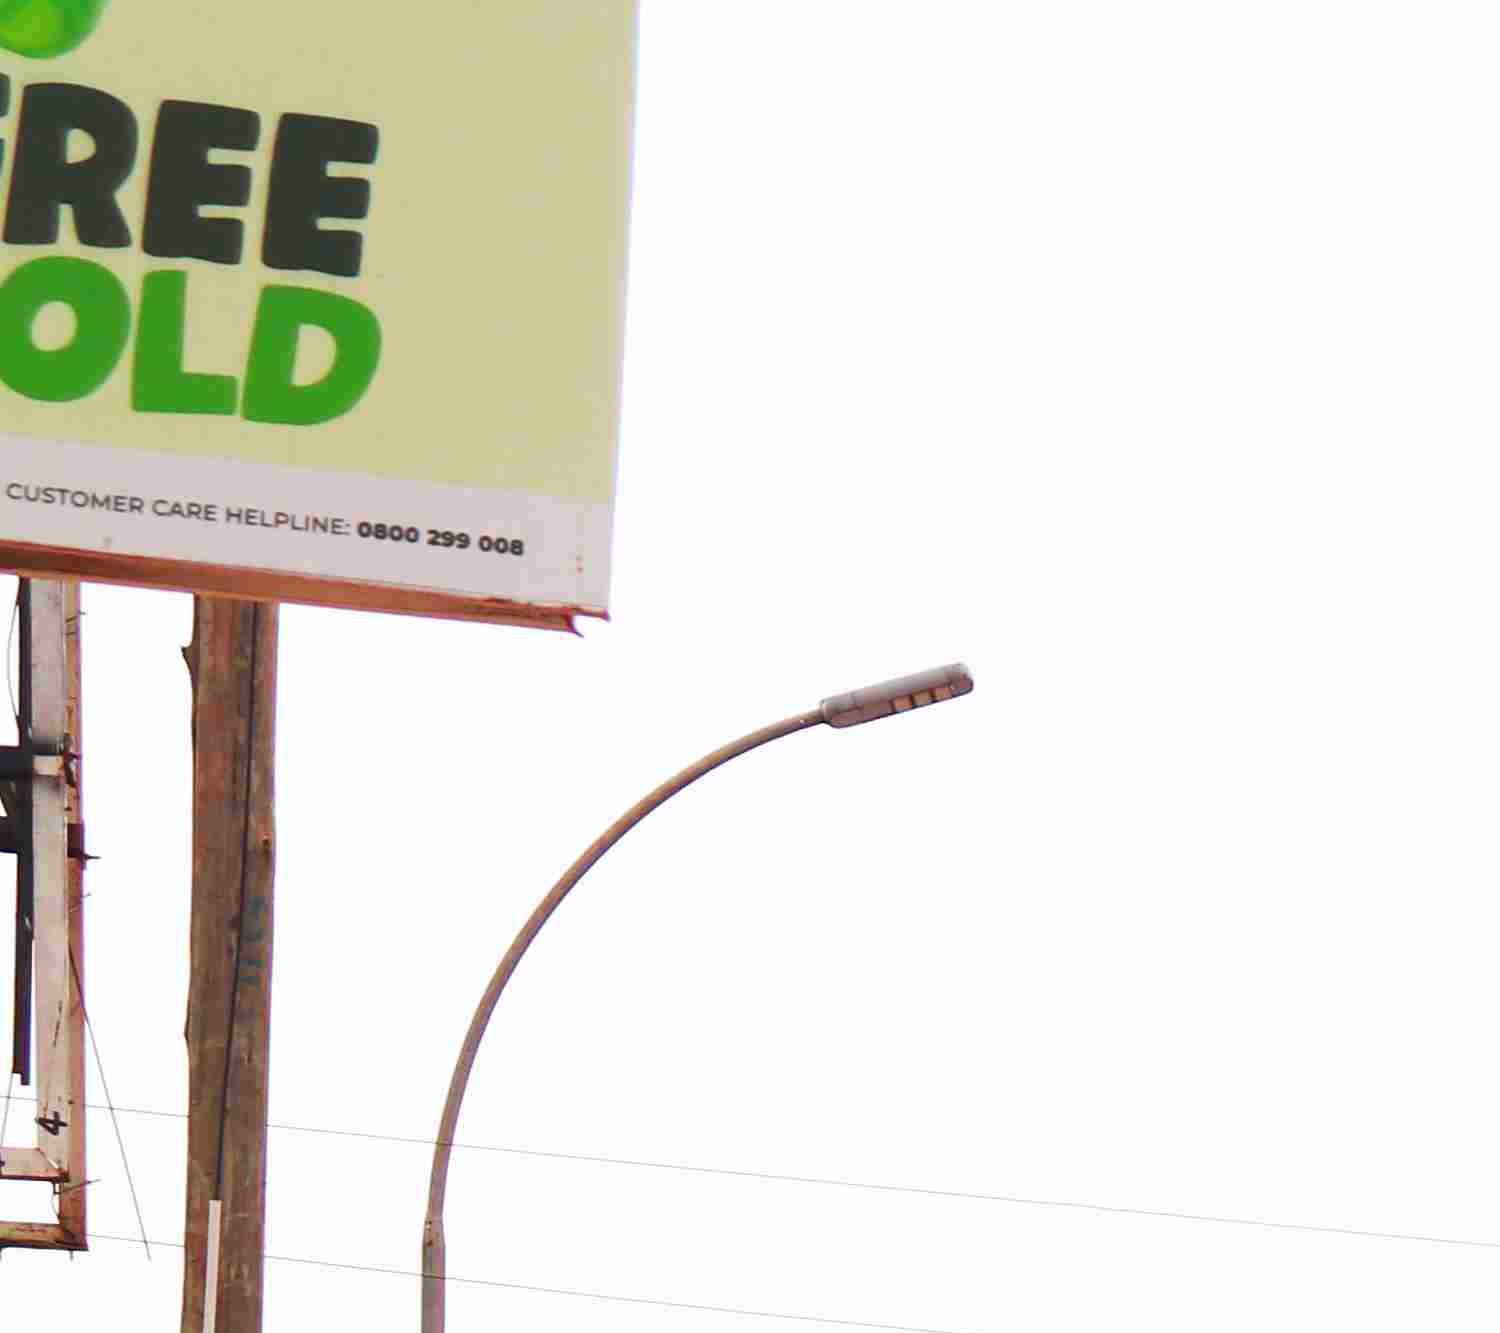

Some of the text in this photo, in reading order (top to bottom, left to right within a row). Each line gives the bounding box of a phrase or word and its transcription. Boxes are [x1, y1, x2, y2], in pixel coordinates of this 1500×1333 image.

[0, 73, 379, 278] REE
[6, 483, 524, 556] CUSTOMER CARE HELPLINE: 0800 299 008
